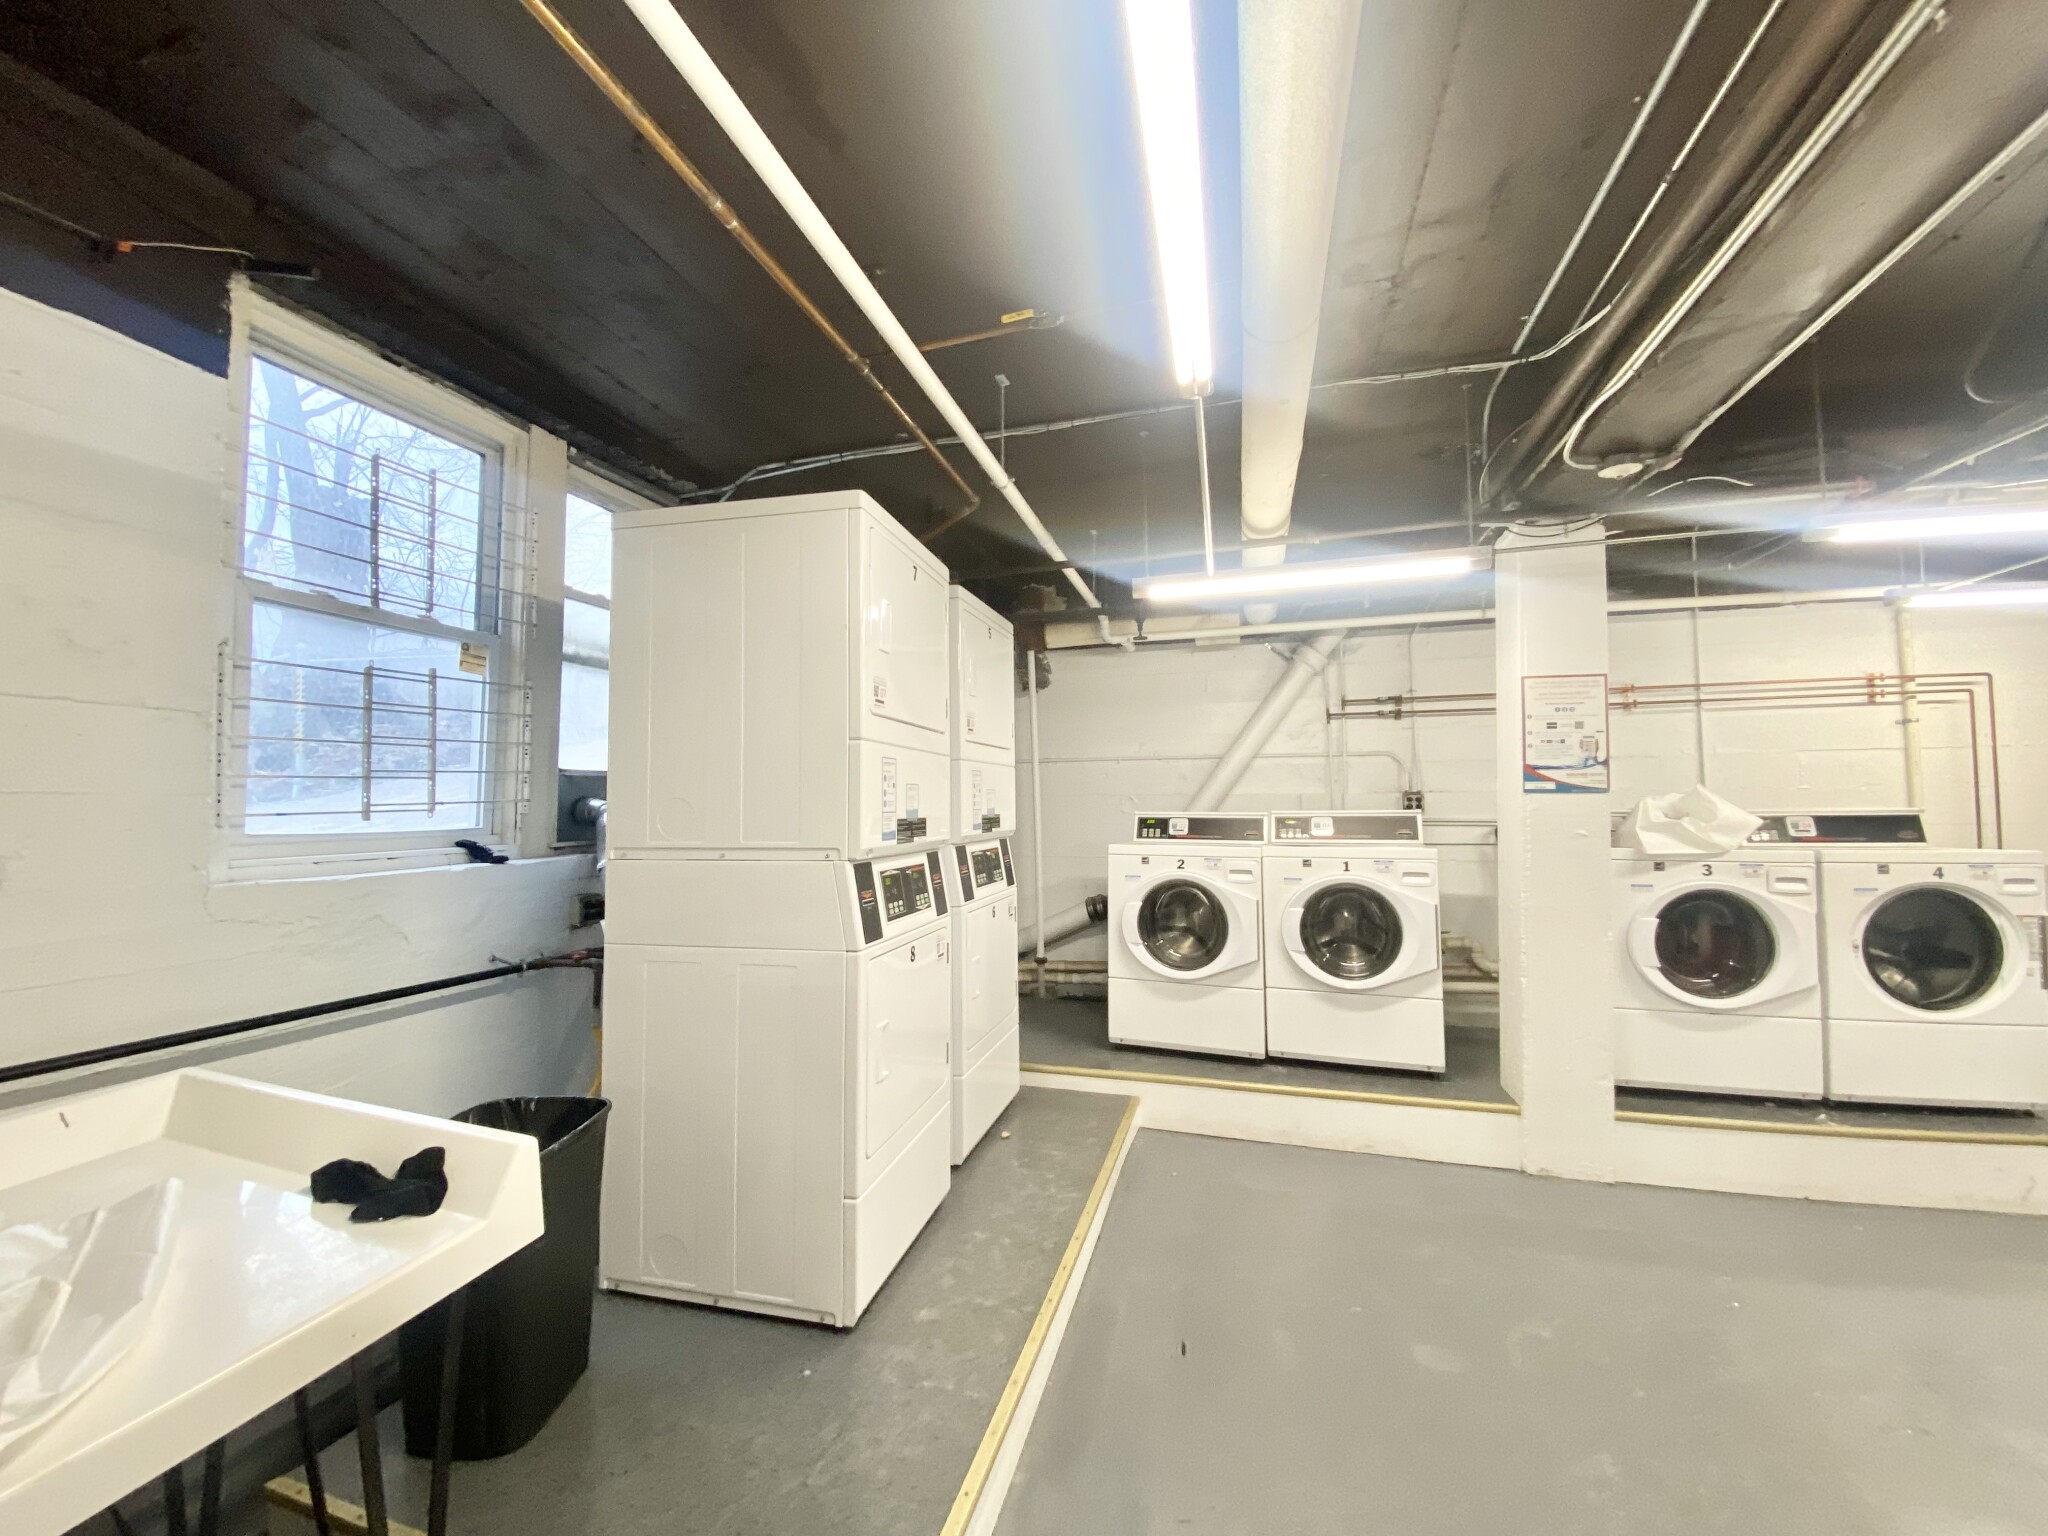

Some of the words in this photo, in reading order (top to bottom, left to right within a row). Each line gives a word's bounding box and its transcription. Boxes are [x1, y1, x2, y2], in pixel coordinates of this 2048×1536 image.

[912, 565, 918, 581] 7
[1176, 859, 1185, 870] 2
[1343, 861, 1351, 872] 1
[1701, 864, 1713, 877] 3
[1932, 866, 1944, 880] 4
[992, 905, 996, 918] 6
[910, 945, 916, 963] 8
